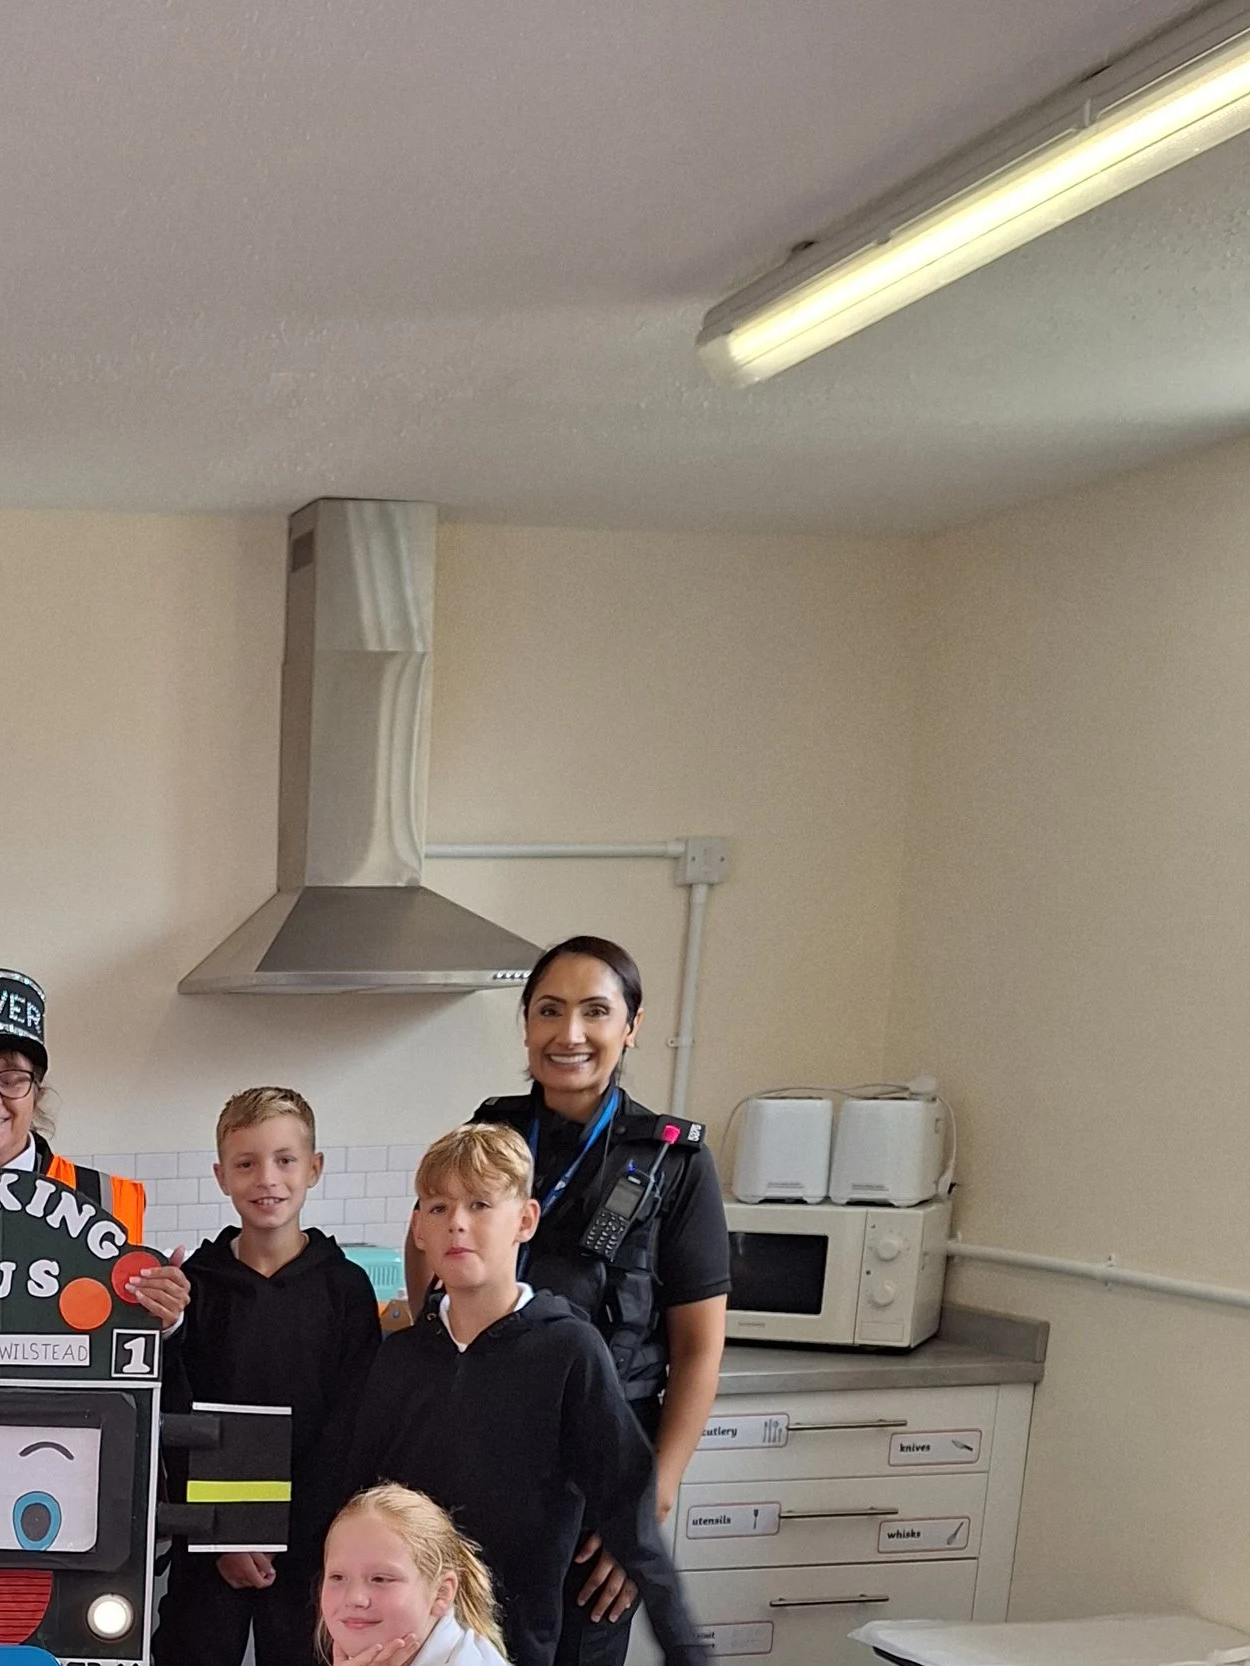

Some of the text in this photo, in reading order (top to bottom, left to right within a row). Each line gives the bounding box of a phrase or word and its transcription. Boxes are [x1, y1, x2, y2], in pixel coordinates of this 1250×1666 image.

[122, 1336, 151, 1374] 1
[899, 1443, 931, 1453] knives
[692, 1515, 731, 1526] utensils
[887, 1529, 921, 1539] whisks
